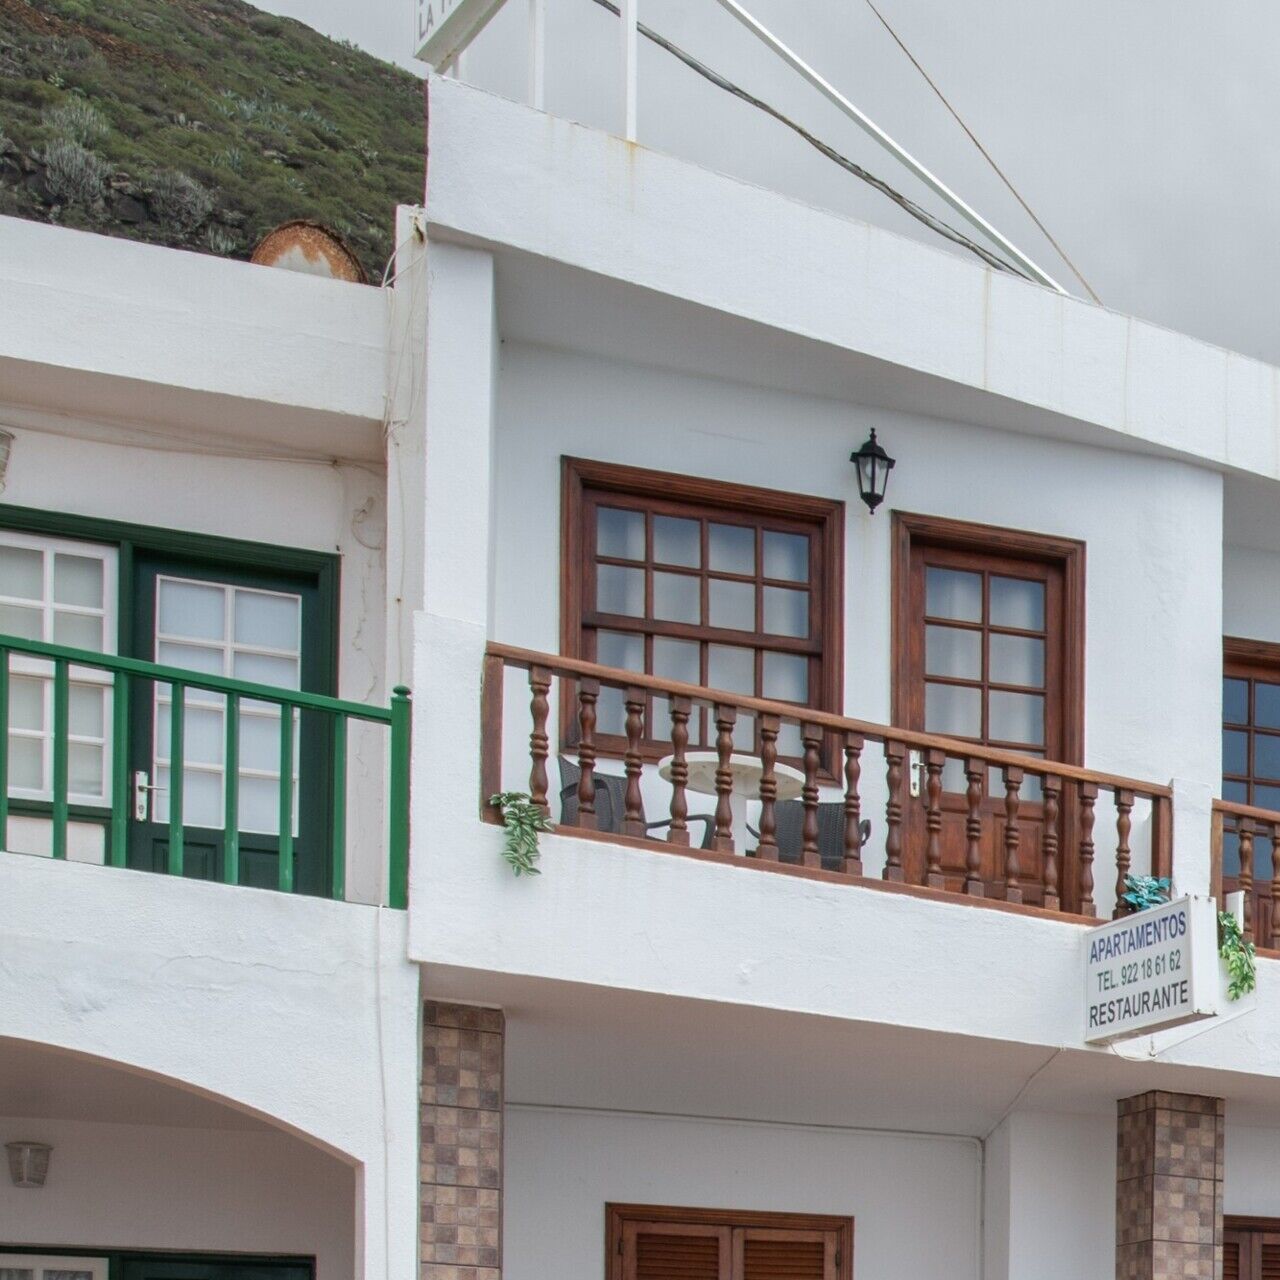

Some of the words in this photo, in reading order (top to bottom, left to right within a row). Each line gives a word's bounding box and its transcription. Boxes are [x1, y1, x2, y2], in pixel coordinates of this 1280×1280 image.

[1089, 910, 1187, 964] APARTAMENTOS
[1097, 968, 1119, 993] TEL.
[1121, 962, 1138, 986] 922
[1141, 957, 1153, 980] 18
[1155, 954, 1166, 976] 61
[1169, 949, 1181, 972] 62
[1089, 979, 1188, 1028] RESTAURANTE
